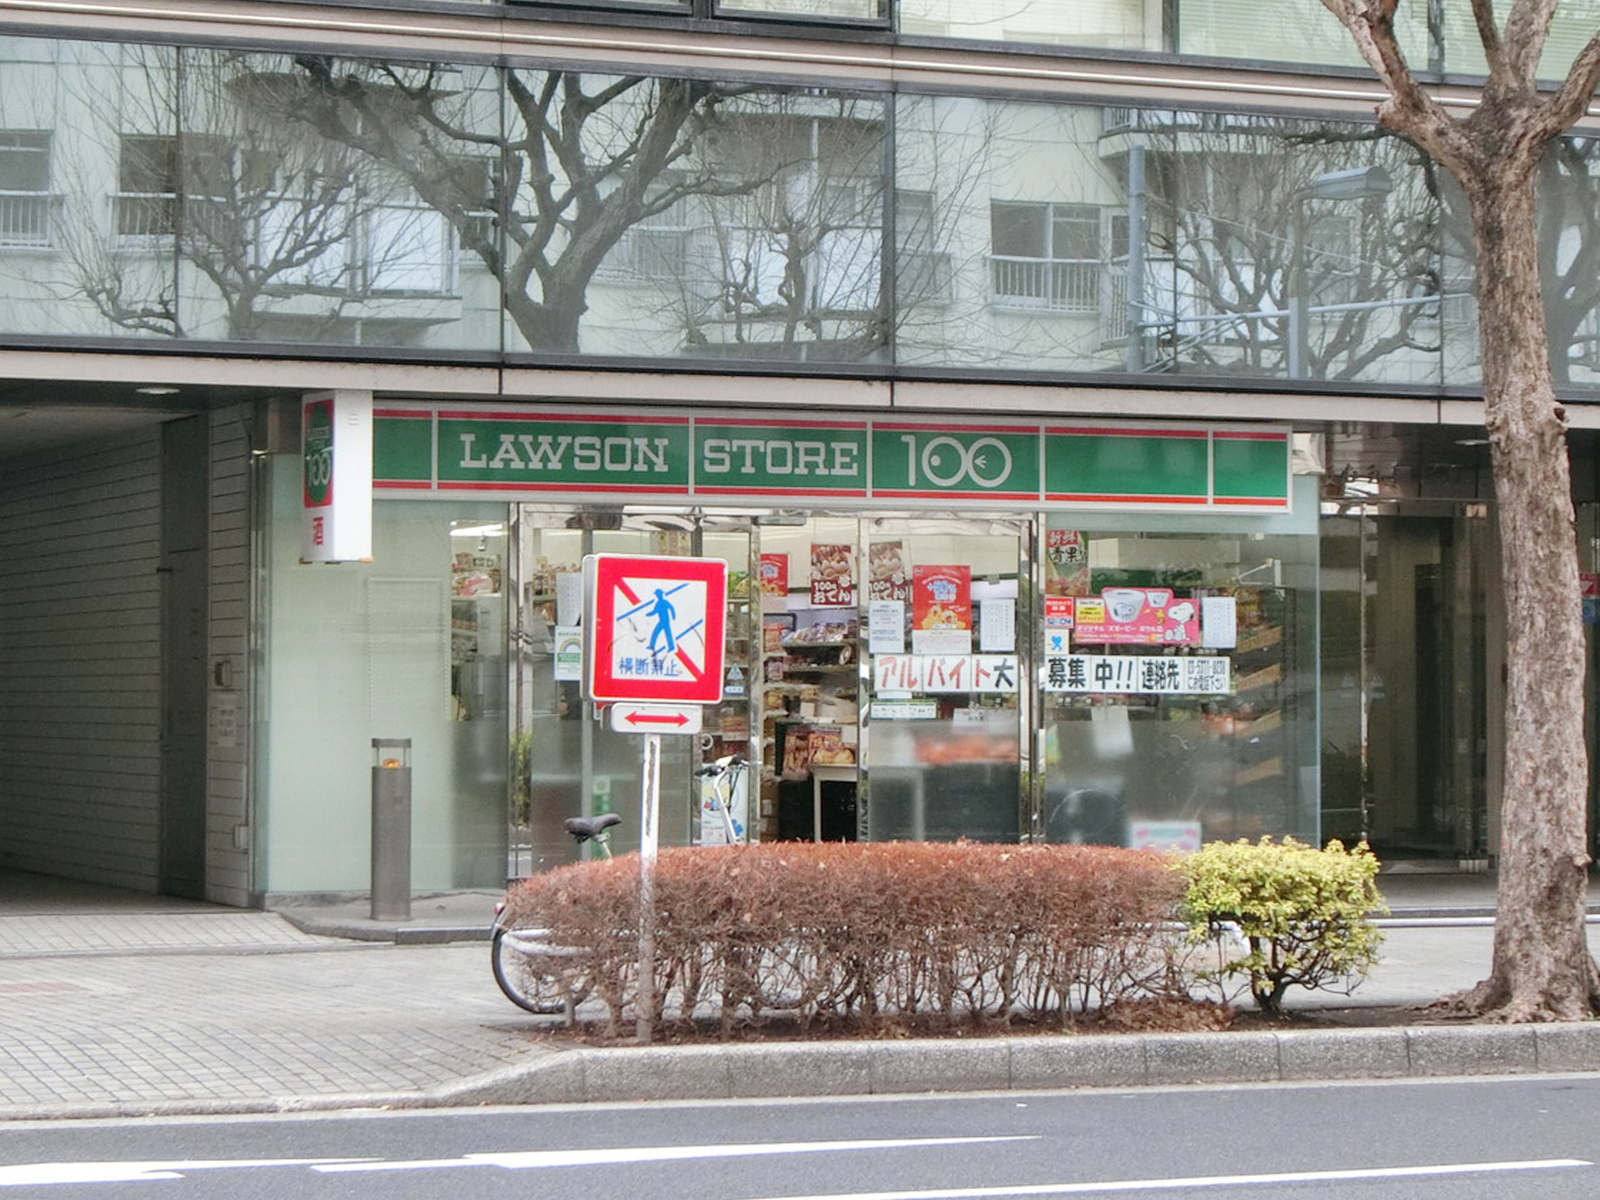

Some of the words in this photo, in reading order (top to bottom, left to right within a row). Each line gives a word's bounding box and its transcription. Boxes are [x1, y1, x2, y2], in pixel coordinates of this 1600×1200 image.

[459, 433, 669, 472] LAWSON
[703, 439, 858, 476] STORE
[901, 434, 1013, 488] 100
[619, 656, 680, 677] 横断禁止
[878, 657, 1015, 689] アルバイト大
